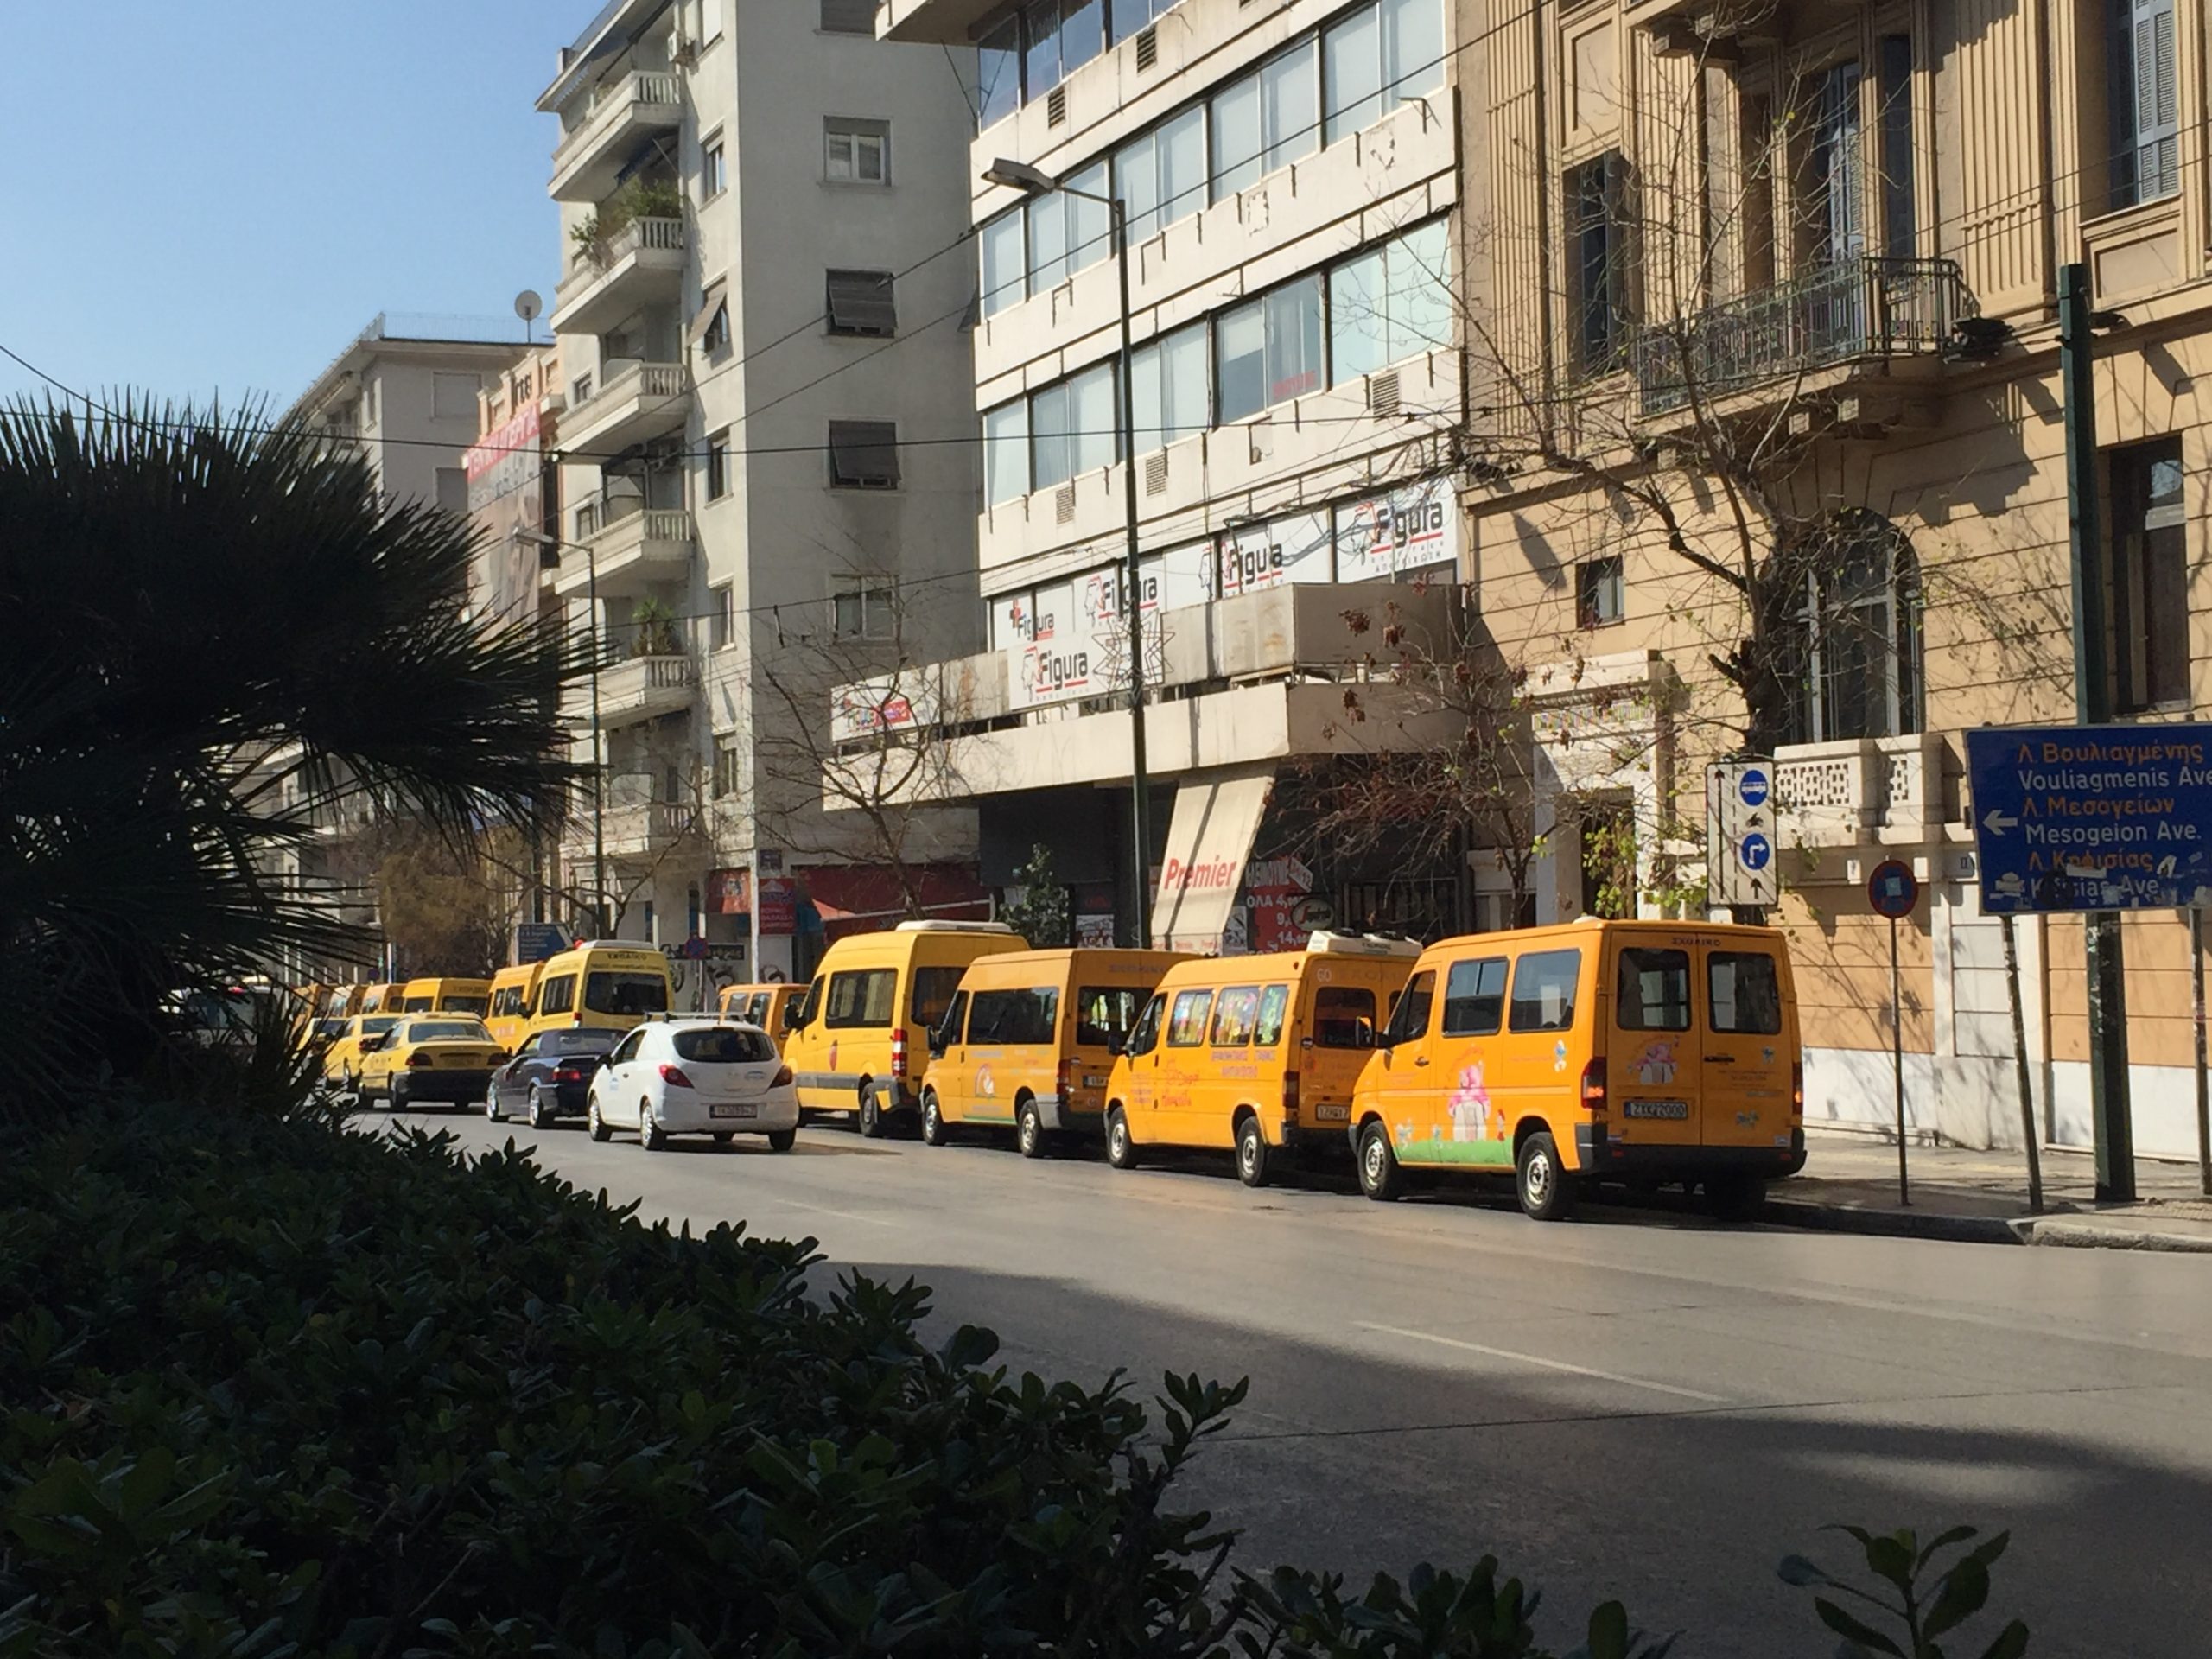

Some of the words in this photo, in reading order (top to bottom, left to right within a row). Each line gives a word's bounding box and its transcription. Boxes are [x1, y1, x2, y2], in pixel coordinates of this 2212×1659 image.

[1230, 543, 1282, 585] Figua
[1103, 576, 1158, 614] Figra
[1039, 650, 1088, 690] Figura
[2043, 740, 2204, 766] Βουλιαγμένης
[2018, 766, 2170, 792] Vouliagmenis
[2048, 792, 2175, 820] Μεσογείων
[2025, 823, 2147, 847] Mesogeion
[2157, 820, 2202, 840] Ave.
[1164, 855, 1237, 891] Premier
